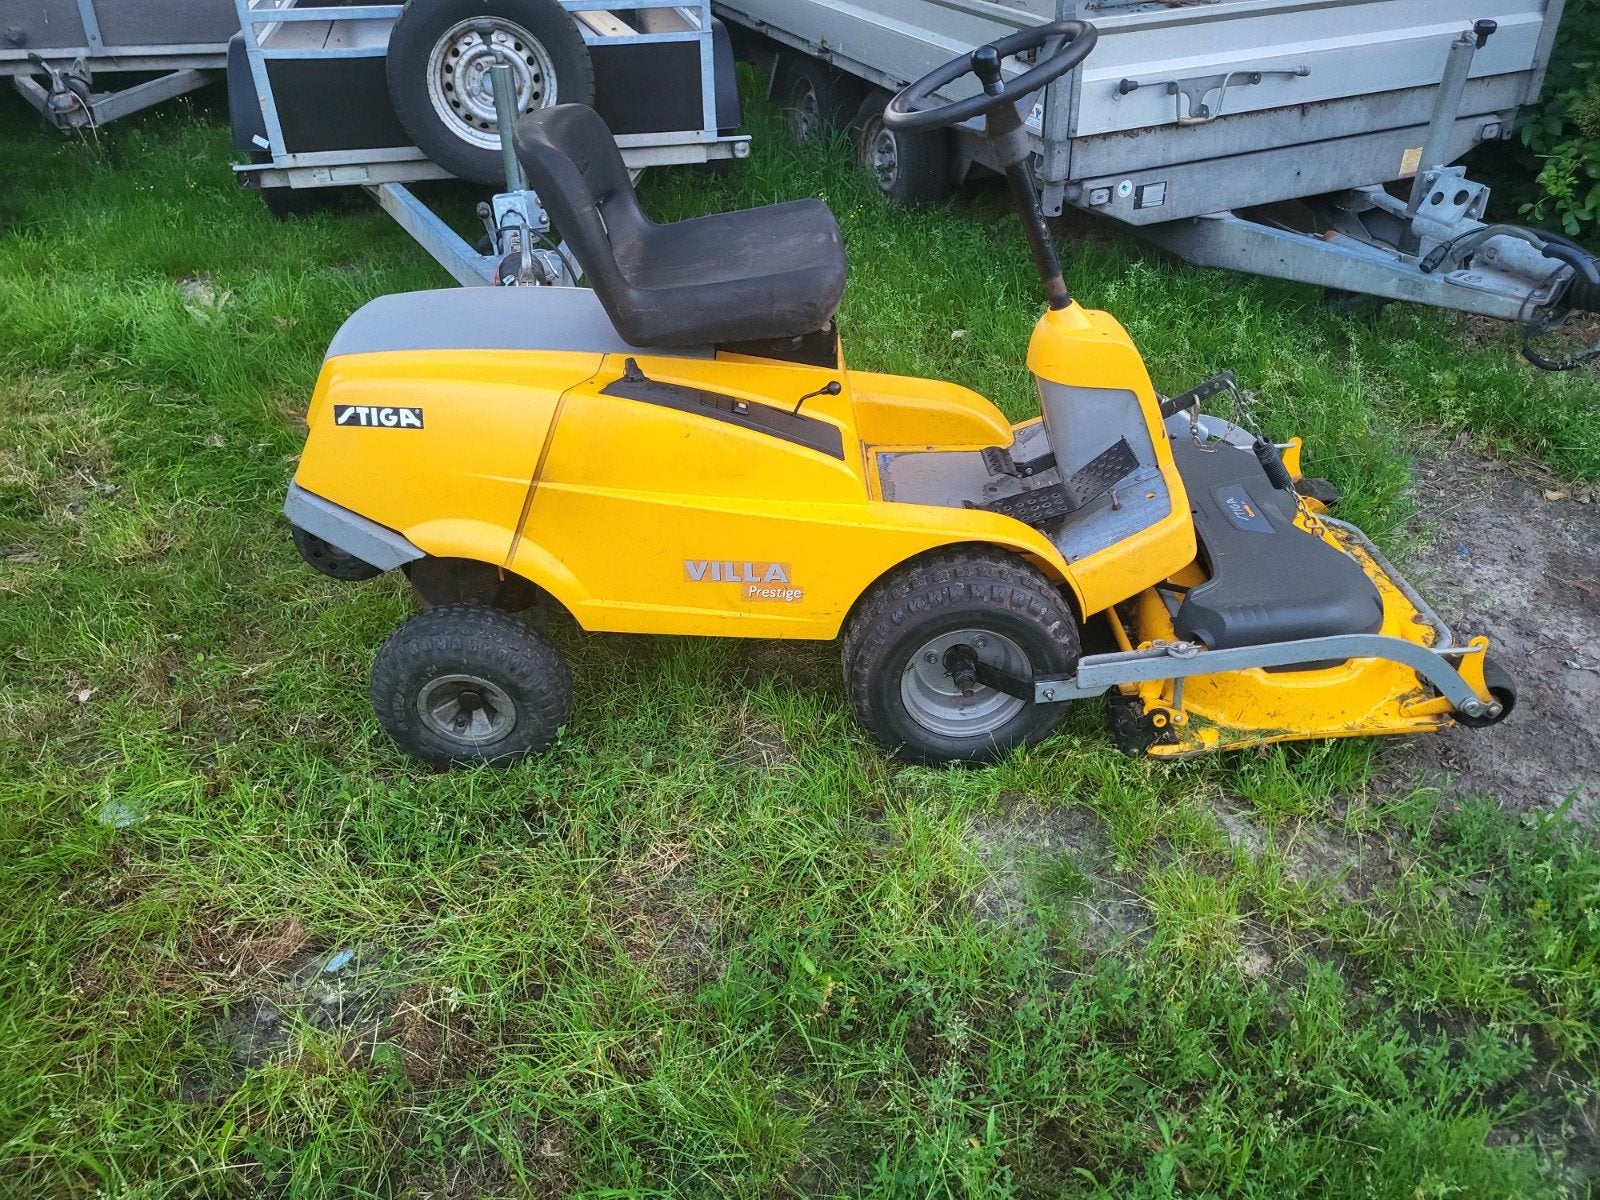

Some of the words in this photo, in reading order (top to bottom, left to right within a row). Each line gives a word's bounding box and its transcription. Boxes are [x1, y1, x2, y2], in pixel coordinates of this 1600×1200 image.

[337, 406, 421, 427] STIGA
[684, 560, 790, 583] VILLA
[748, 585, 802, 601] Prestige
